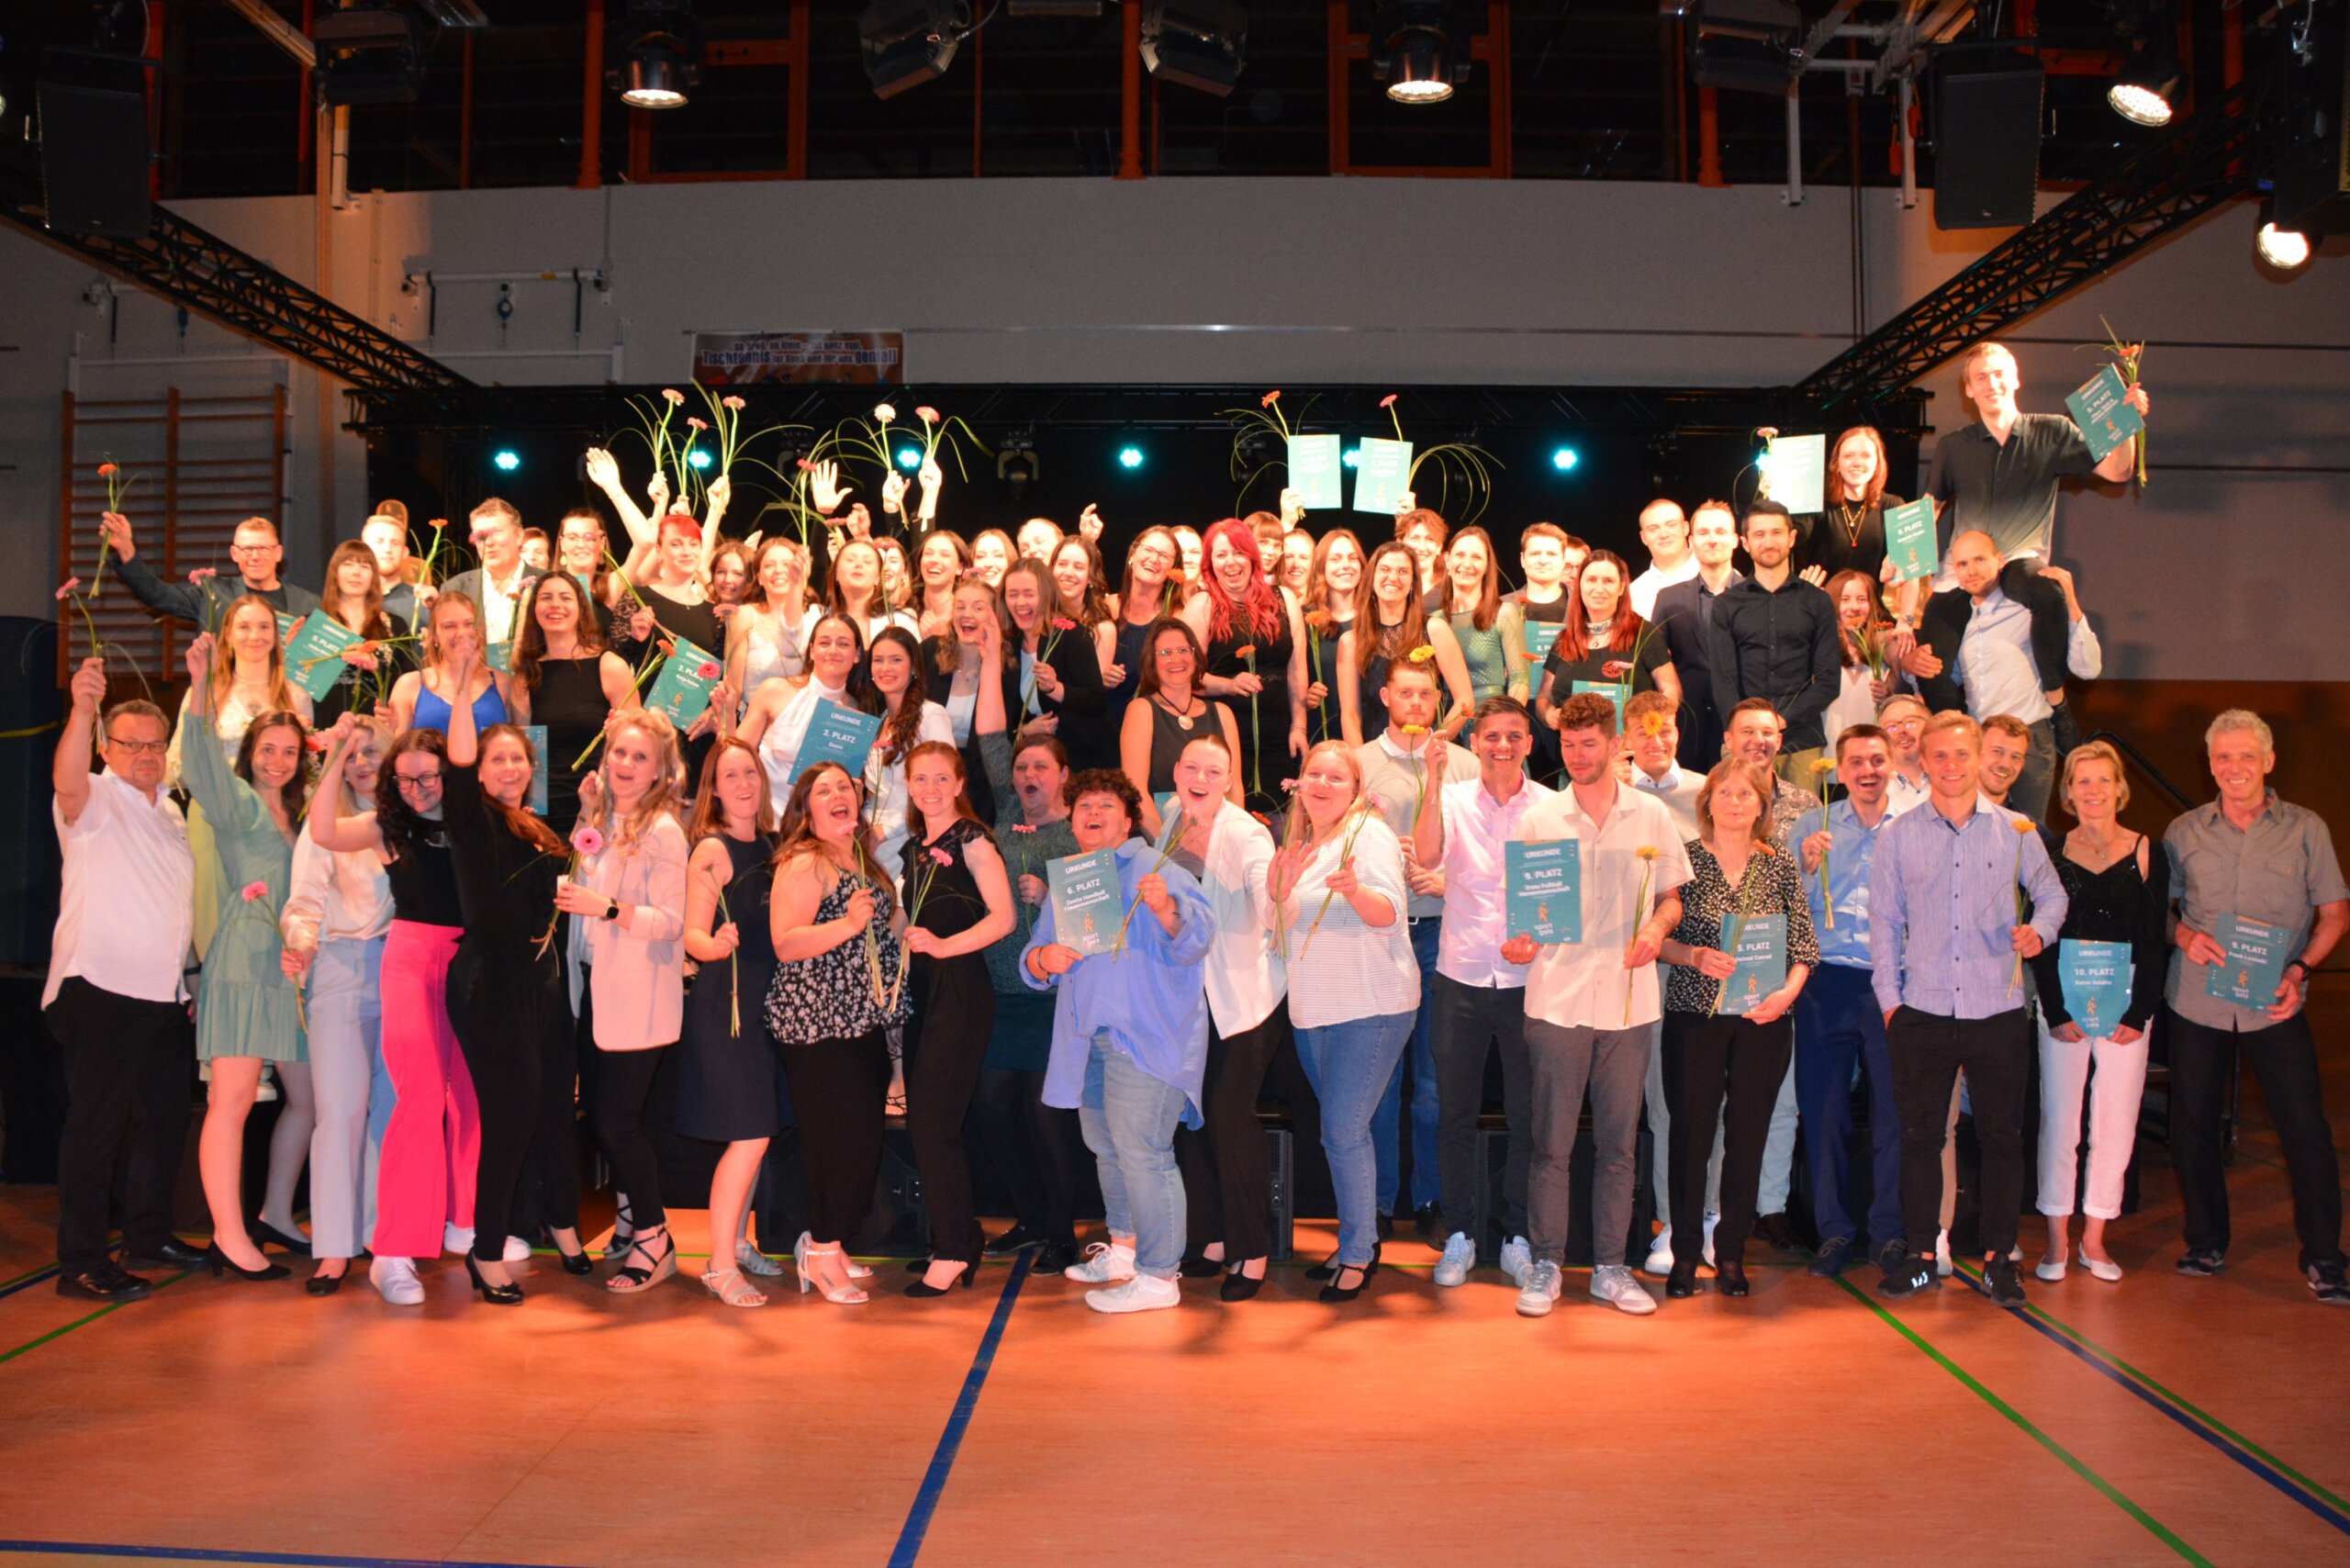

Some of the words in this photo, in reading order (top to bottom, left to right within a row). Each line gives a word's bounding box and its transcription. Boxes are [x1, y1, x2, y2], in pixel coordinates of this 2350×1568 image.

[703, 352, 770, 364] Tischtennis
[831, 712, 862, 726] URKUNDE
[822, 729, 831, 737] 2.
[832, 732, 856, 744] PLATZ
[1525, 848, 1561, 858] URKUNDE
[1065, 859, 1097, 874] URKUNDE
[1534, 868, 1563, 879] PLATZ
[1067, 887, 1076, 895] 6.
[1076, 879, 1102, 892] PLATZ
[2235, 925, 2269, 938] URKUNDE
[1737, 944, 1745, 952] 5.
[1746, 942, 1770, 951] PLATZ
[2232, 941, 2240, 949] 9.
[2241, 944, 2267, 956] PLATZ
